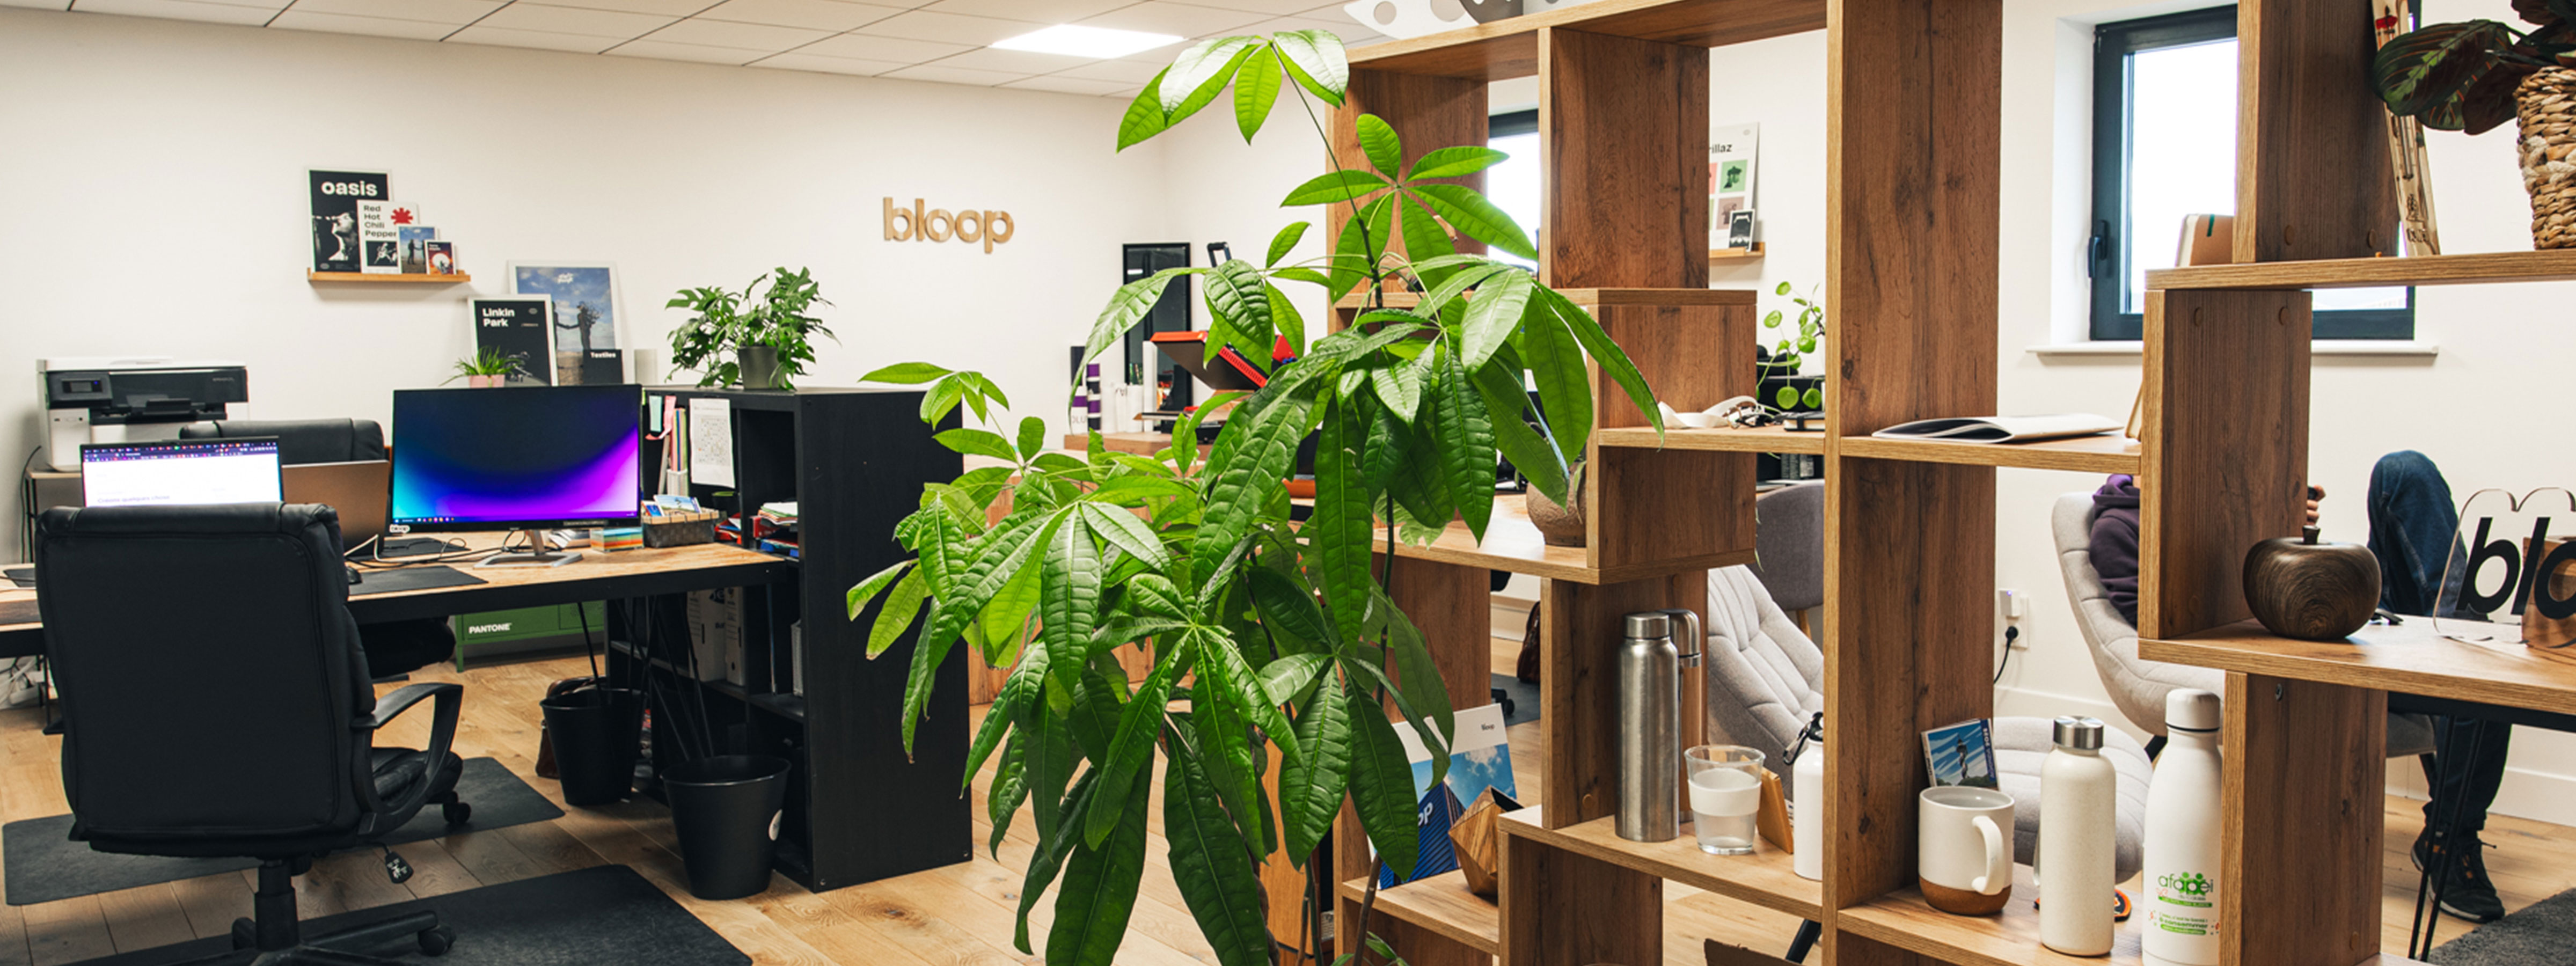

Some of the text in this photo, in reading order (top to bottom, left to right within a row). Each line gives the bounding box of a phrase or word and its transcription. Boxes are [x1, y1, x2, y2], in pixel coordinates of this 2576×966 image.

[321, 180, 378, 196] oasis
[883, 196, 1014, 254] bloop
[482, 308, 515, 317] Linkin
[483, 318, 509, 327] Park
[469, 623, 511, 634] PANTONE
